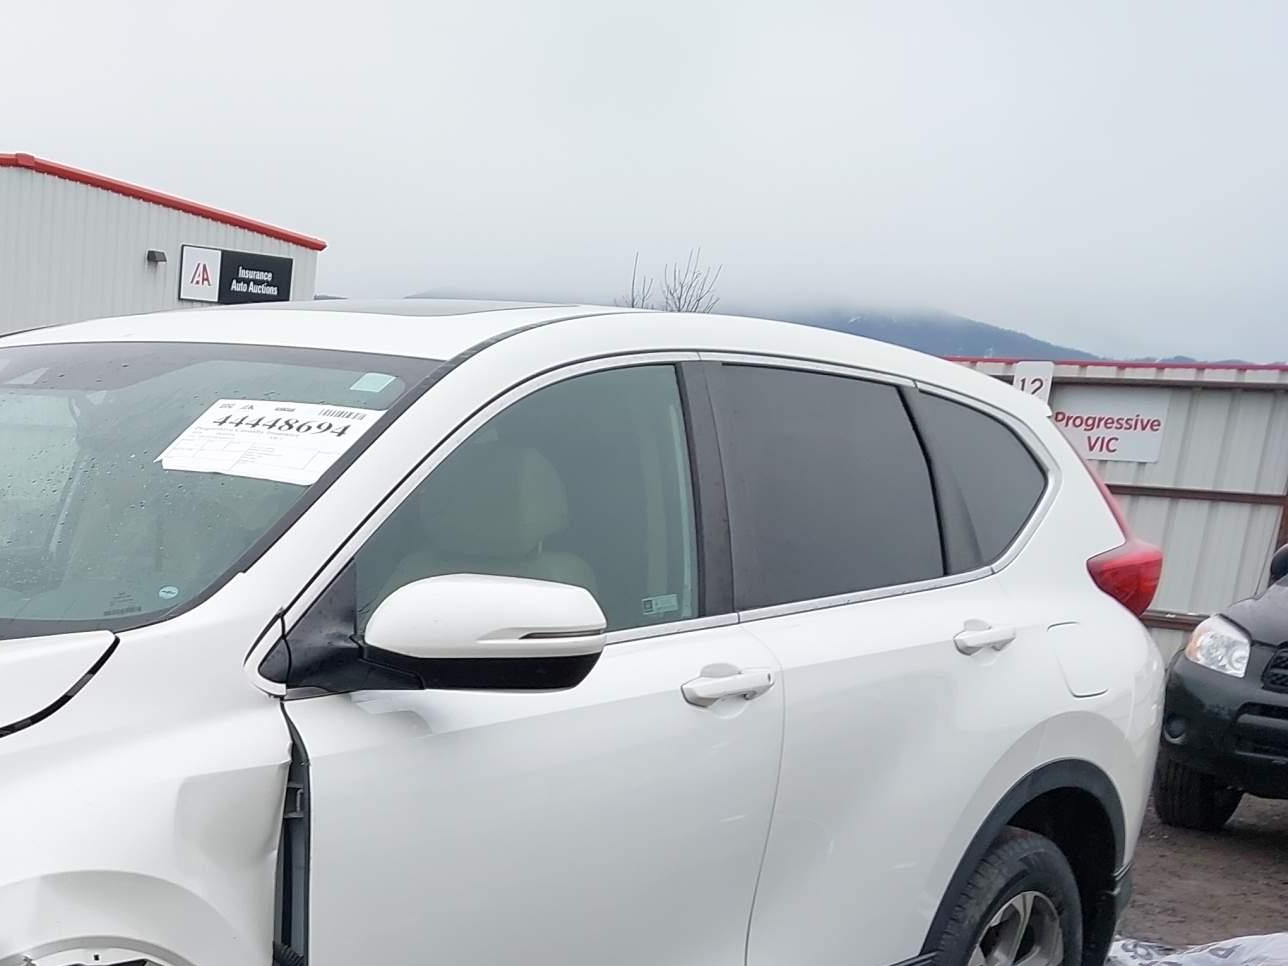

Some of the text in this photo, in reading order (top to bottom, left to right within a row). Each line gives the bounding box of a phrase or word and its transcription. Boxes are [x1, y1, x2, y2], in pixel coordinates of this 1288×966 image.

[238, 266, 272, 281] Insurance
[230, 279, 278, 295] Auto Auctions
[213, 413, 351, 438] 44448694
[1054, 410, 1161, 432] Progressive
[1087, 436, 1119, 453] VIC
